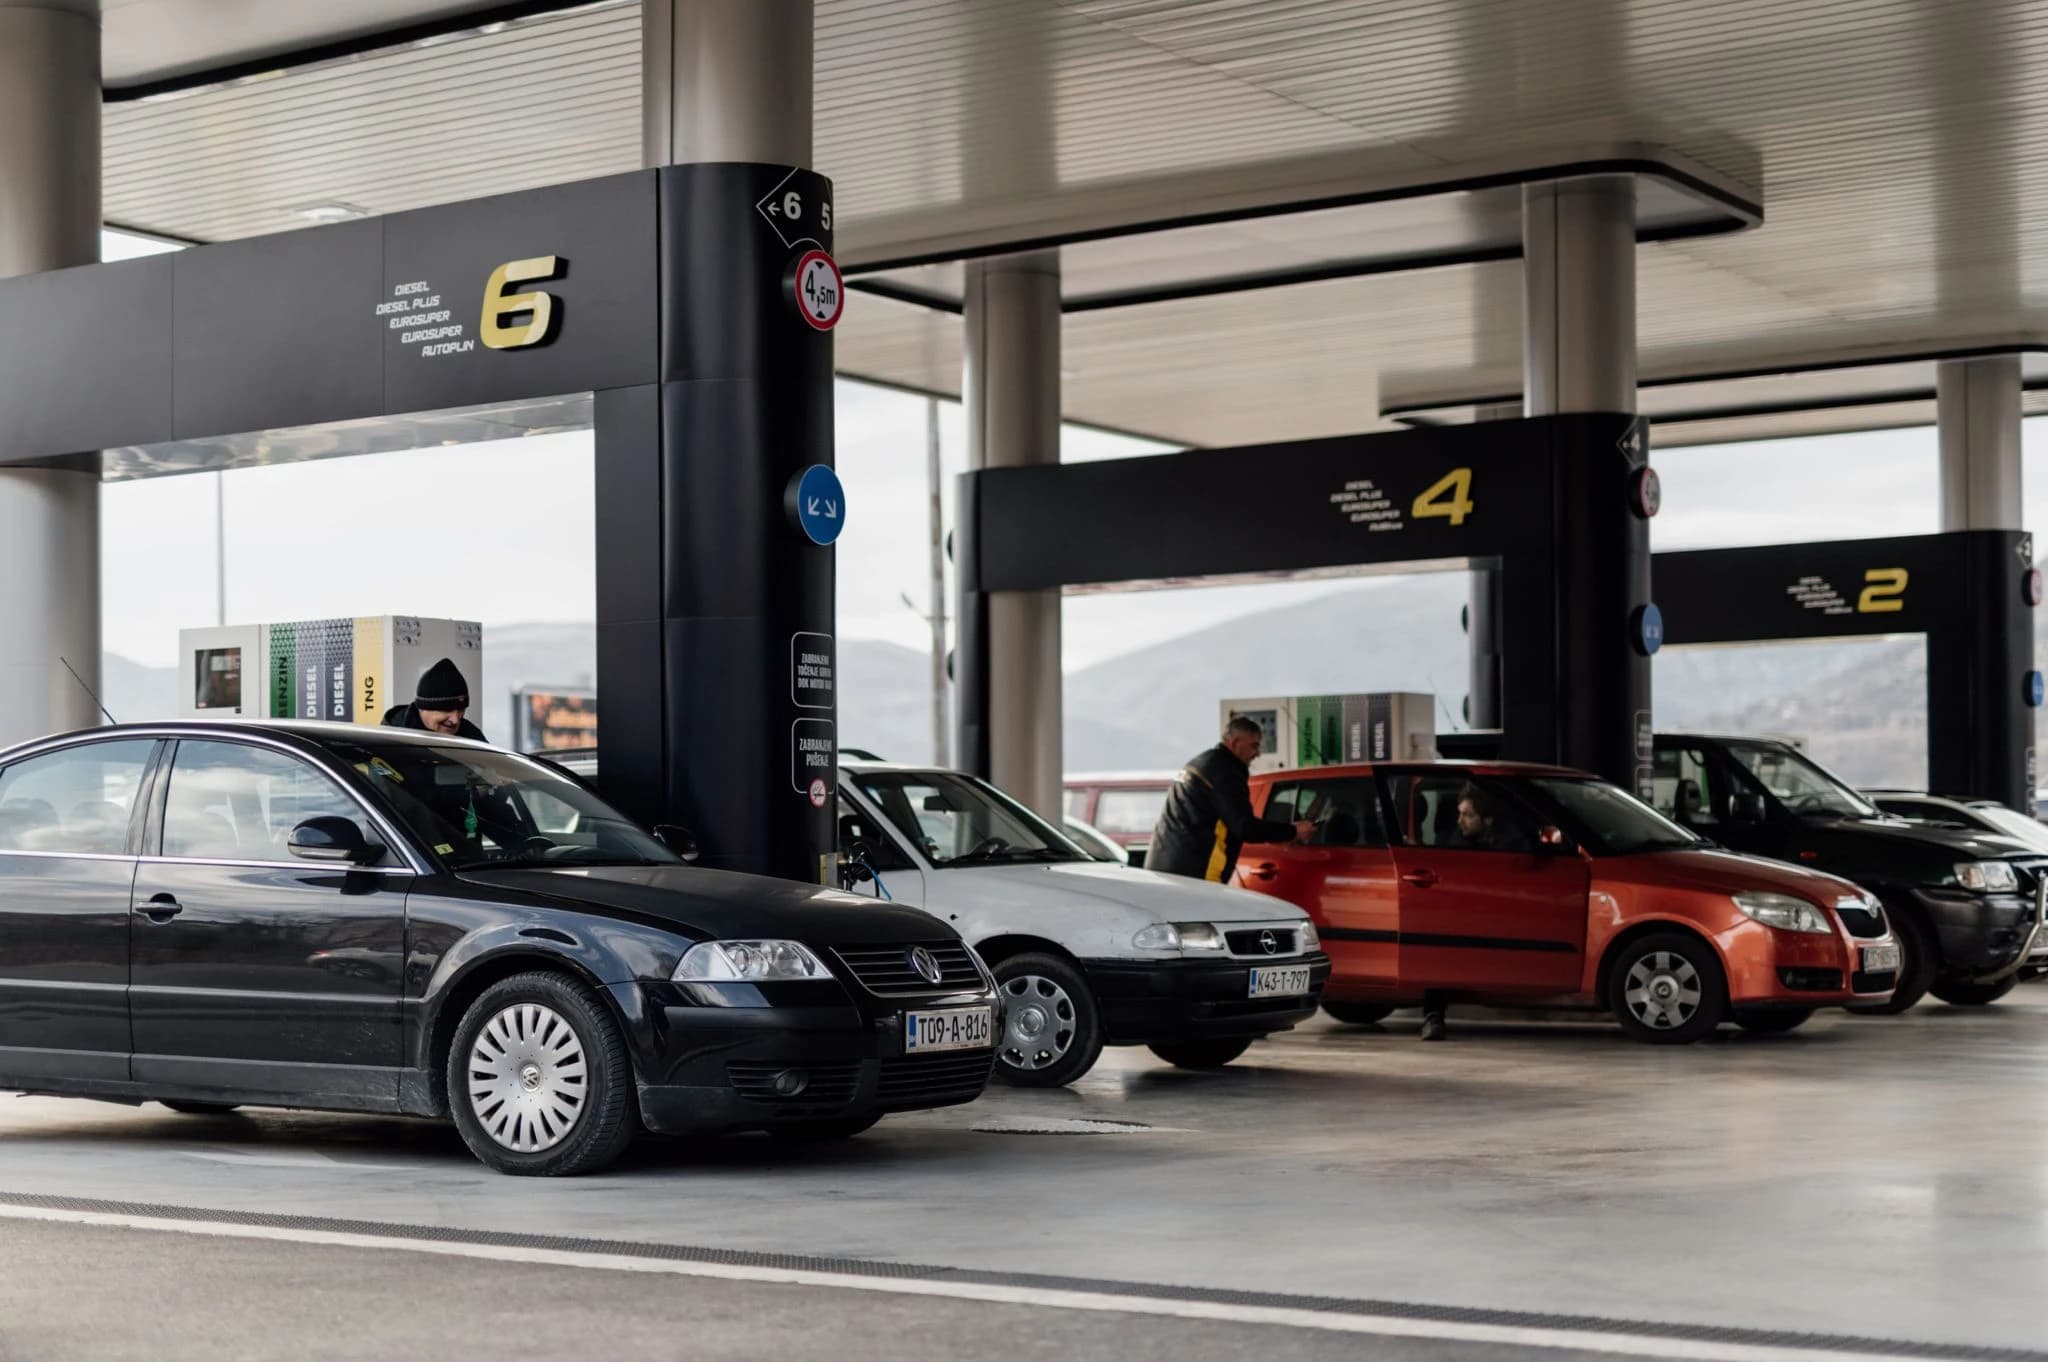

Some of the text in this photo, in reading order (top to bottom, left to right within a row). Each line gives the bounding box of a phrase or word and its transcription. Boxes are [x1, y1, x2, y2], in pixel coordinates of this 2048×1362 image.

[783, 192, 801, 220] 6
[821, 203, 831, 230] 5
[394, 281, 430, 296] DIESEL
[480, 255, 557, 350] 6
[805, 270, 835, 307] 4,5m
[375, 294, 441, 315] DIESEL PLUS
[389, 310, 451, 329] EUROSUPER
[401, 325, 463, 344] EUROSUPER
[421, 340, 475, 357] AUTOPLIN
[1411, 467, 1474, 526] 4
[1858, 567, 1909, 613] 2
[306, 664, 317, 718] DIESEL
[334, 663, 344, 716] DIESEL
[364, 676, 374, 712] TNG
[1257, 970, 1308, 992] K43-T-797
[918, 1013, 988, 1045] T09-A-816
